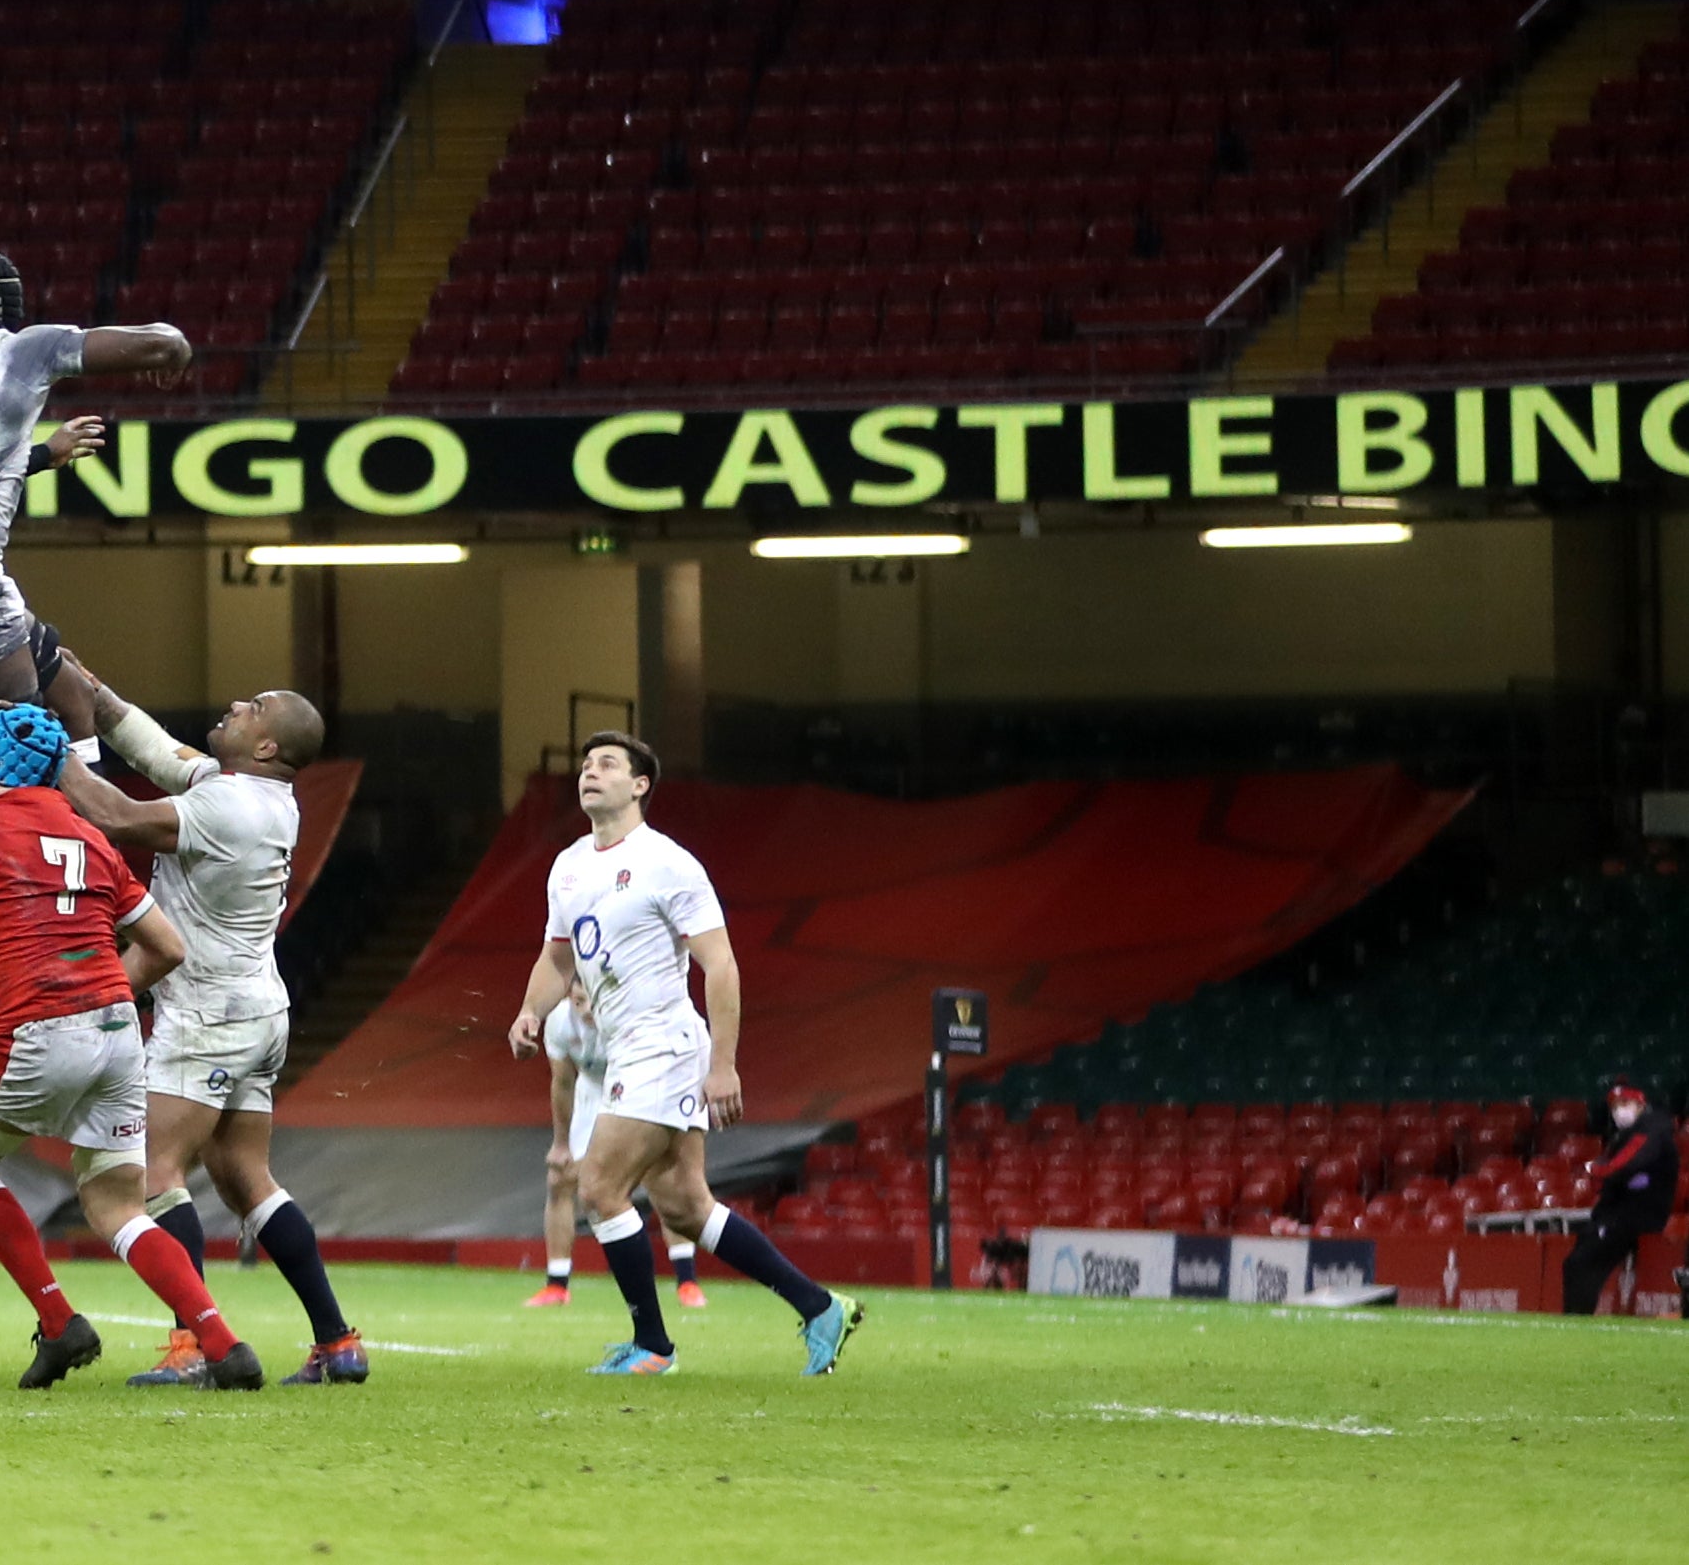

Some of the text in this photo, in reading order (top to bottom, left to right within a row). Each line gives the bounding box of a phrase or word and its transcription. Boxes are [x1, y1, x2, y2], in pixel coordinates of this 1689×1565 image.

[573, 396, 1279, 511] CASTLE
[39, 835, 87, 915] 7
[573, 915, 613, 973] O2
[112, 1120, 146, 1137] ISU
